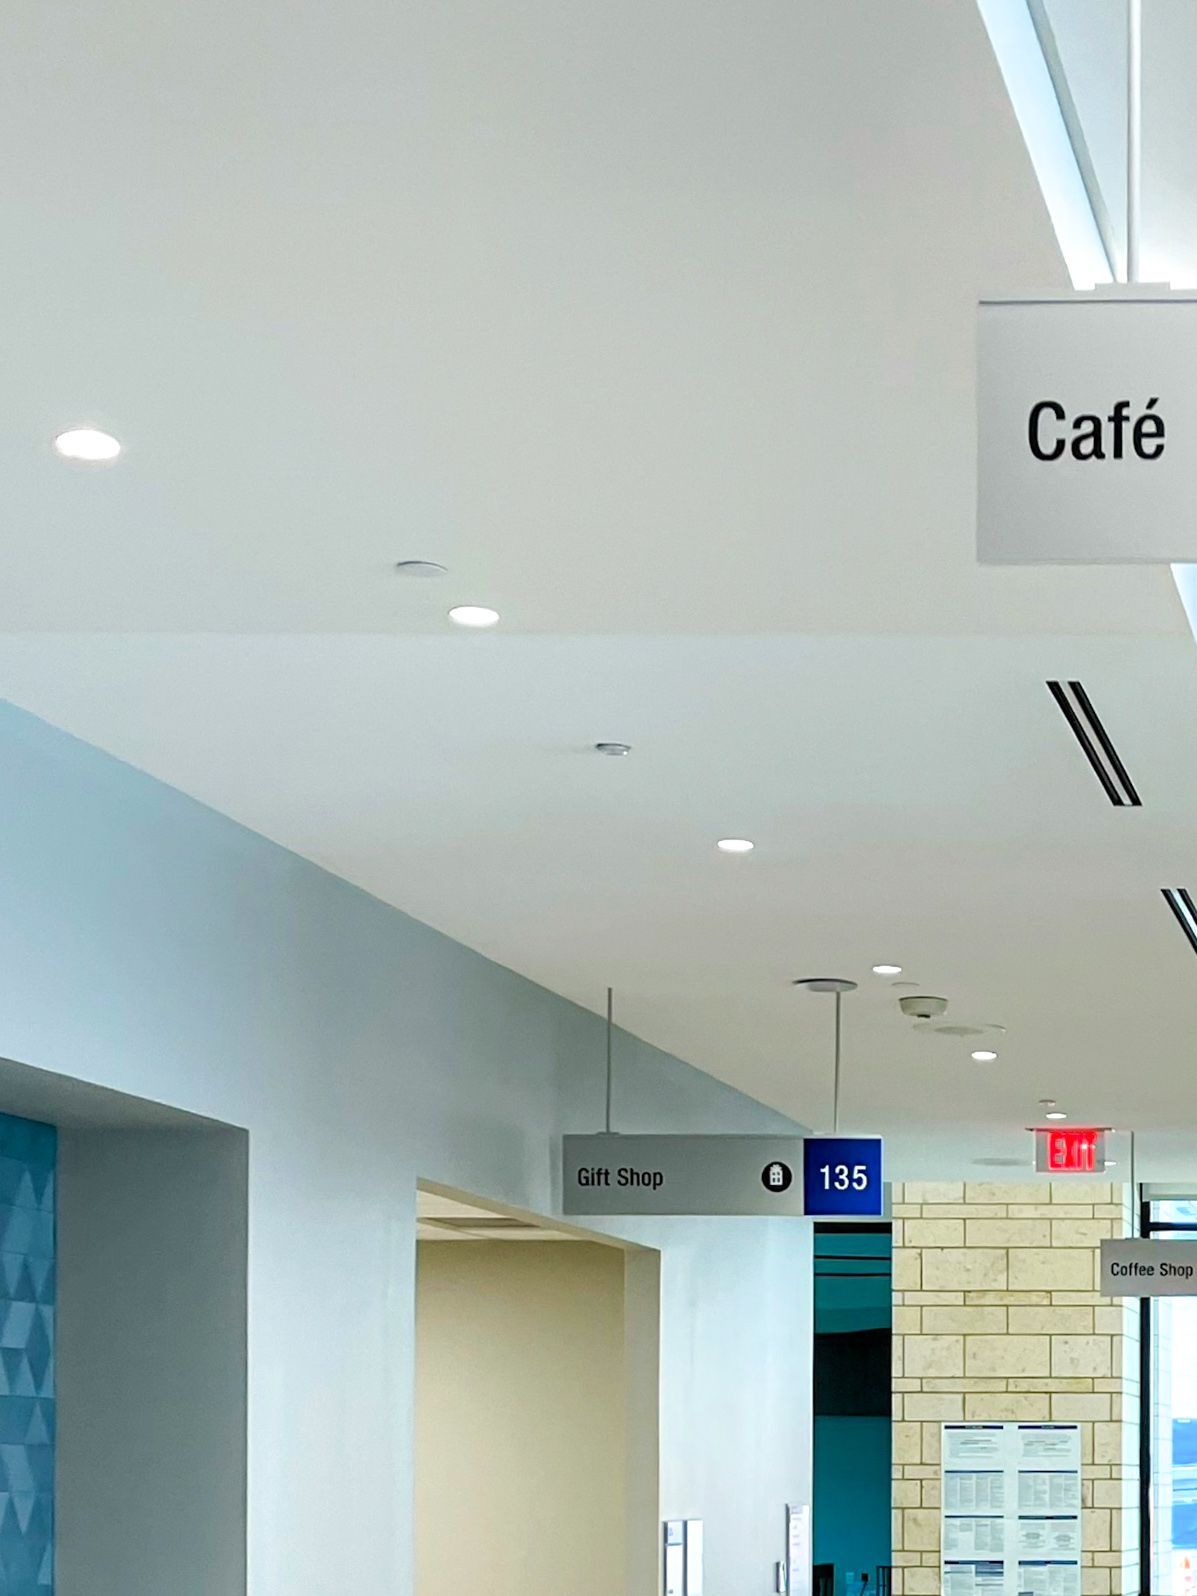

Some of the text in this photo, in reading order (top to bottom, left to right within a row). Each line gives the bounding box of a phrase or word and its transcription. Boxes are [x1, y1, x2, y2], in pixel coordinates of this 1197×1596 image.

[1028, 397, 1165, 462] Café
[1049, 1131, 1098, 1169] EXIT
[577, 1167, 664, 1190] Gift Shop
[820, 1164, 868, 1191] 135
[1110, 1262, 1194, 1280] Coffee Shop
